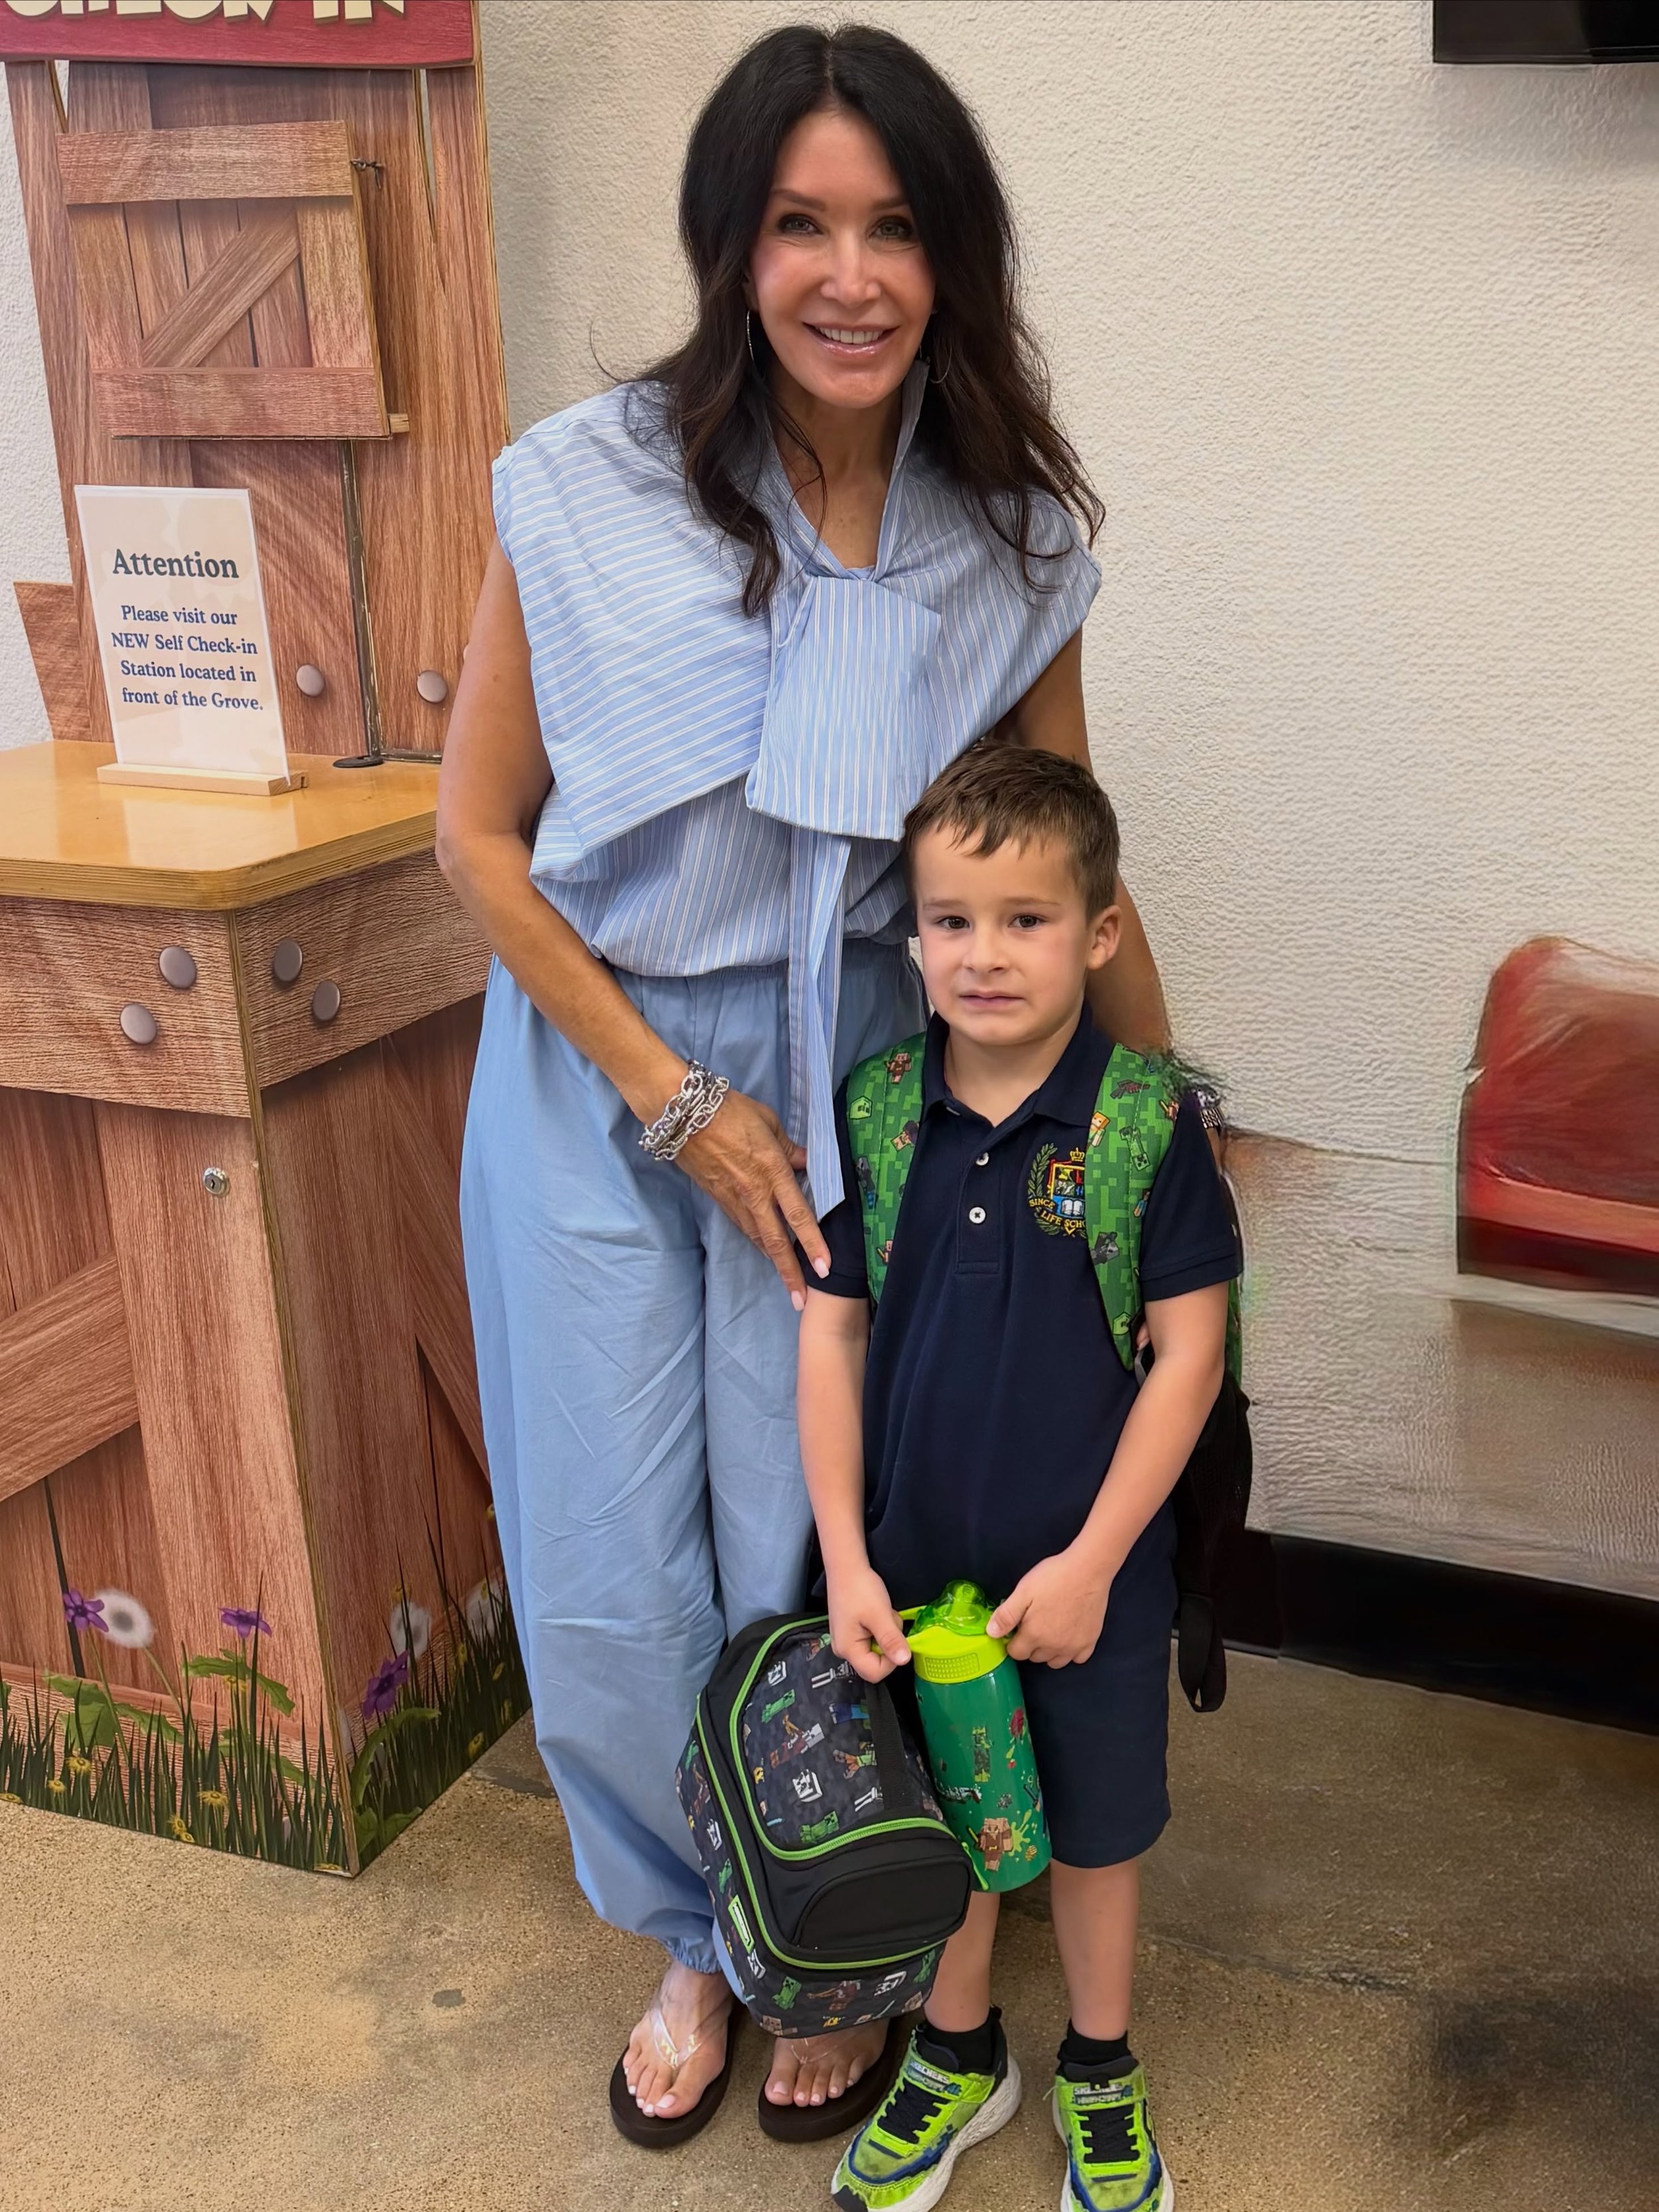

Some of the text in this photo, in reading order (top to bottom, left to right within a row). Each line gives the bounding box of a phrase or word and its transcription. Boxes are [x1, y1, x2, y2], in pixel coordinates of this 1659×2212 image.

[112, 548, 240, 579] Attention
[121, 605, 238, 625] Please visit our
[111, 632, 258, 654] NEW Self Check-in
[120, 660, 257, 682] Station located in
[122, 687, 264, 710] front of the Grove.
[1029, 1198, 1056, 1209] SINCE
[1040, 1210, 1063, 1226] LIFE
